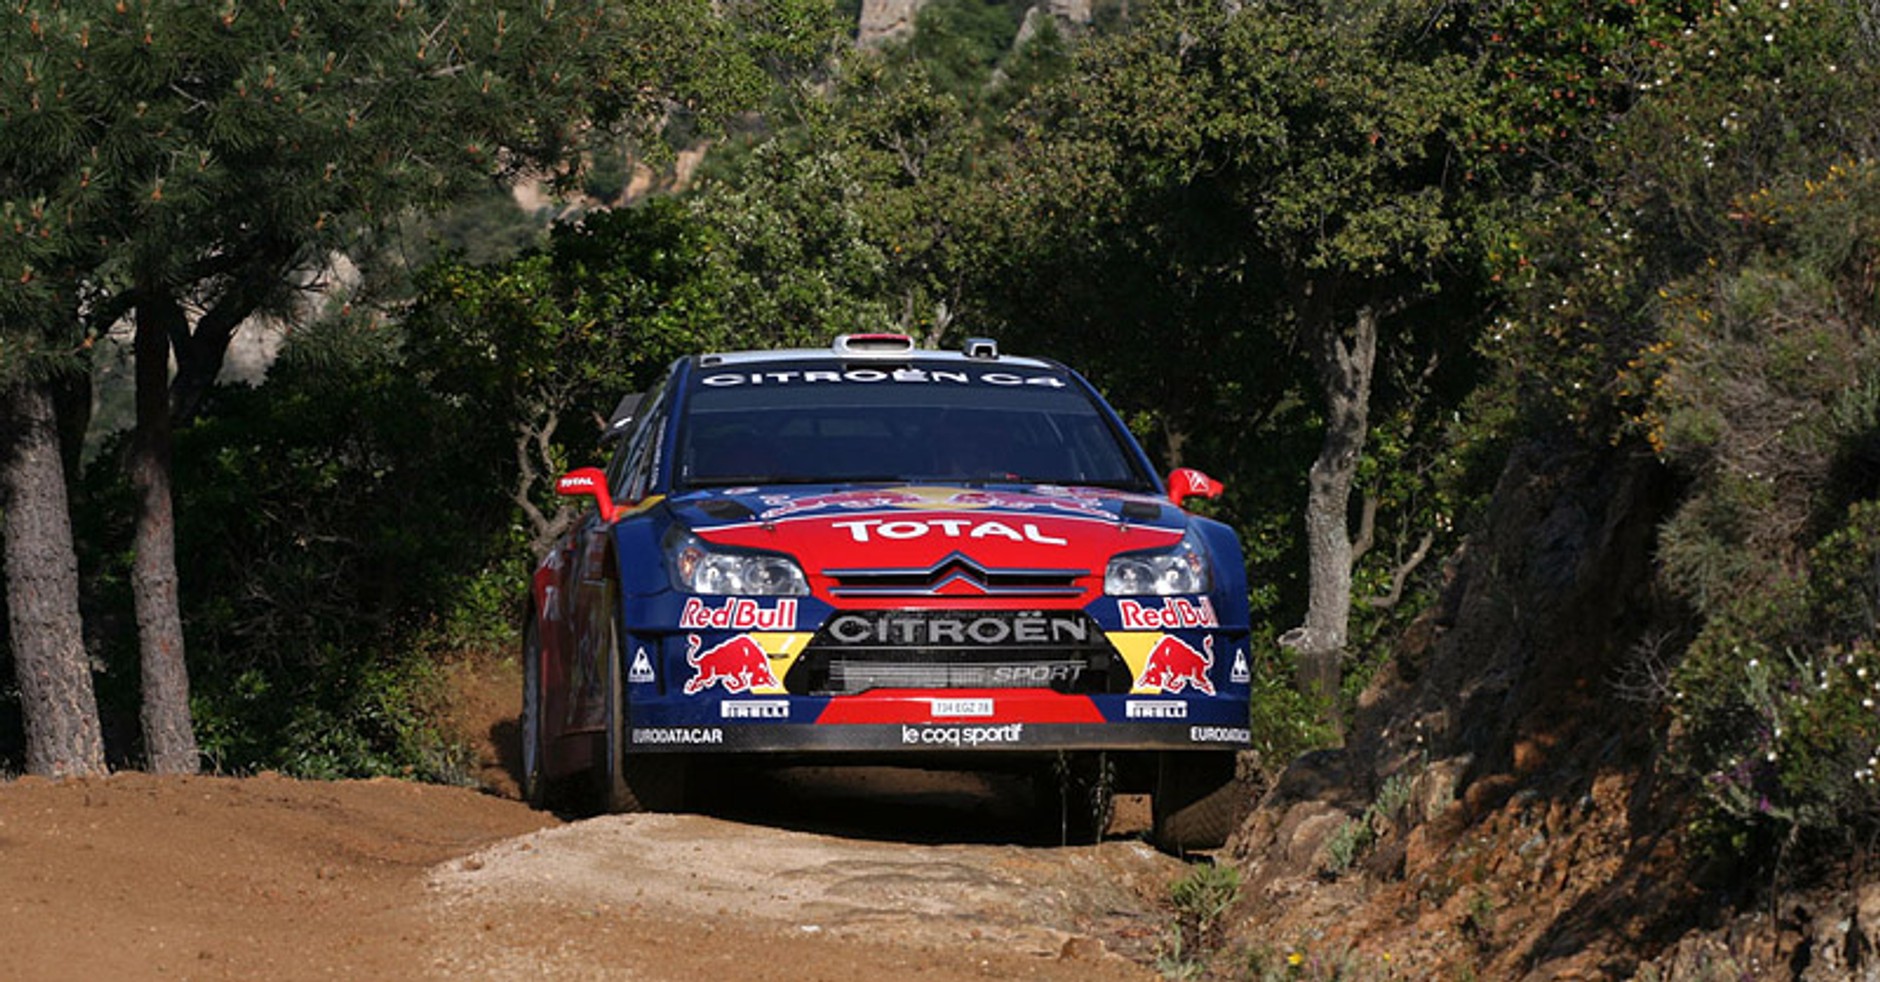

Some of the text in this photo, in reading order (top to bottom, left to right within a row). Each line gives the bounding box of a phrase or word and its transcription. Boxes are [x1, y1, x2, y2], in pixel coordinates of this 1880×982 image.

[702, 368, 1066, 388] CITROËN C4
[561, 477, 594, 487] TOTAL
[831, 519, 1068, 546] TOTAL
[679, 597, 798, 630] Red Bull
[1117, 597, 1181, 629] Red
[828, 611, 1087, 643] CITROËN
[993, 664, 1088, 681] SPORT
[721, 700, 791, 718] PIRELLI
[1125, 700, 1188, 718] PIRELLI
[632, 728, 723, 744] EURODATACAR
[902, 723, 1023, 748] le coq sportif
